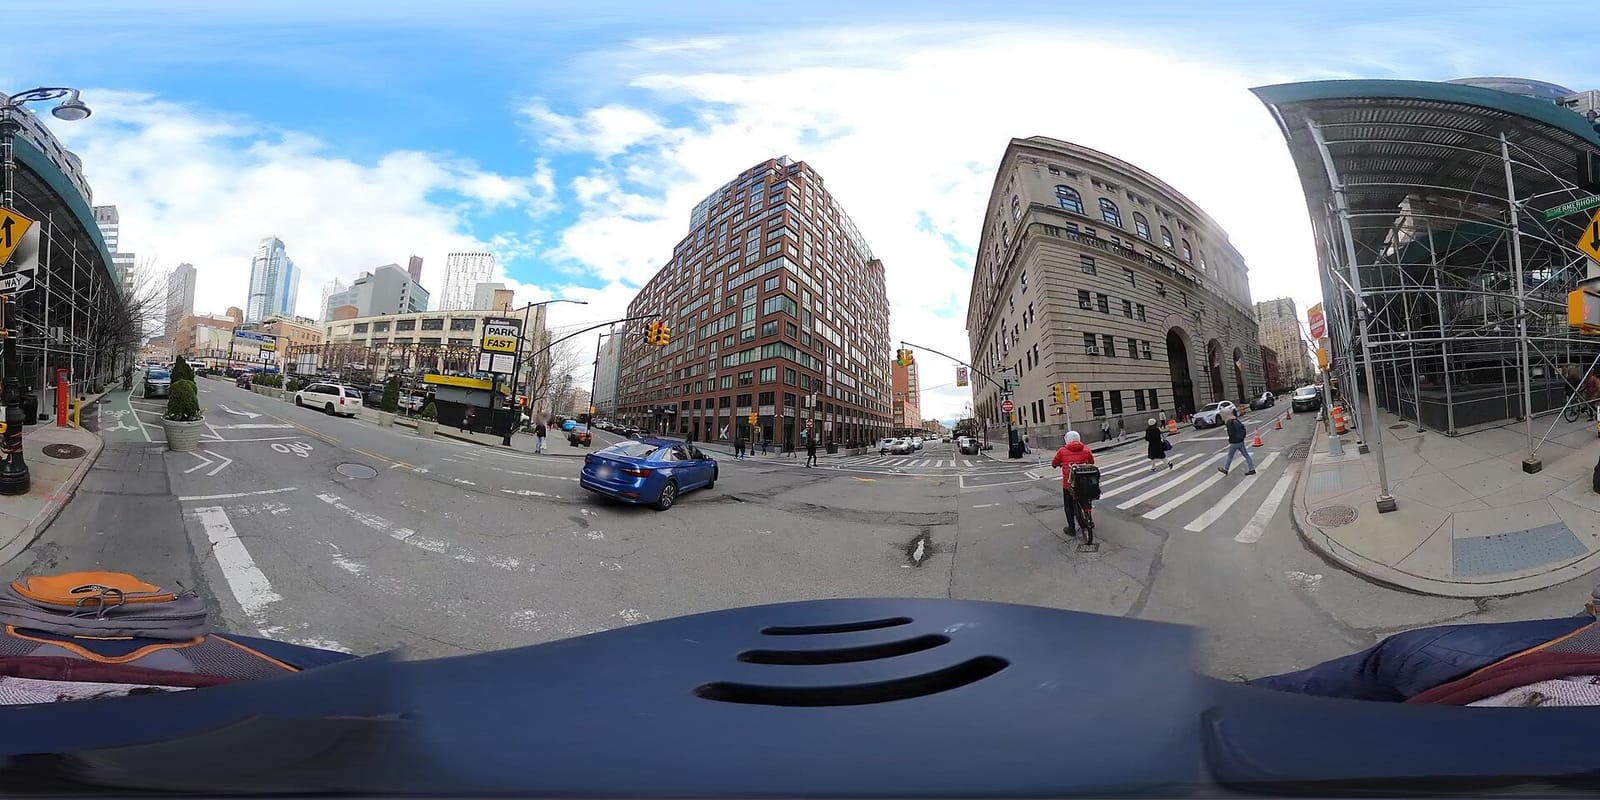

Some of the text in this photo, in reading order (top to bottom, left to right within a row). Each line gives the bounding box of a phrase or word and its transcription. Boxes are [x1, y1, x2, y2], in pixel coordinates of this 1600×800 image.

[5, 277, 22, 287] WAY
[488, 327, 515, 336] PARK
[487, 339, 513, 348] FAST
